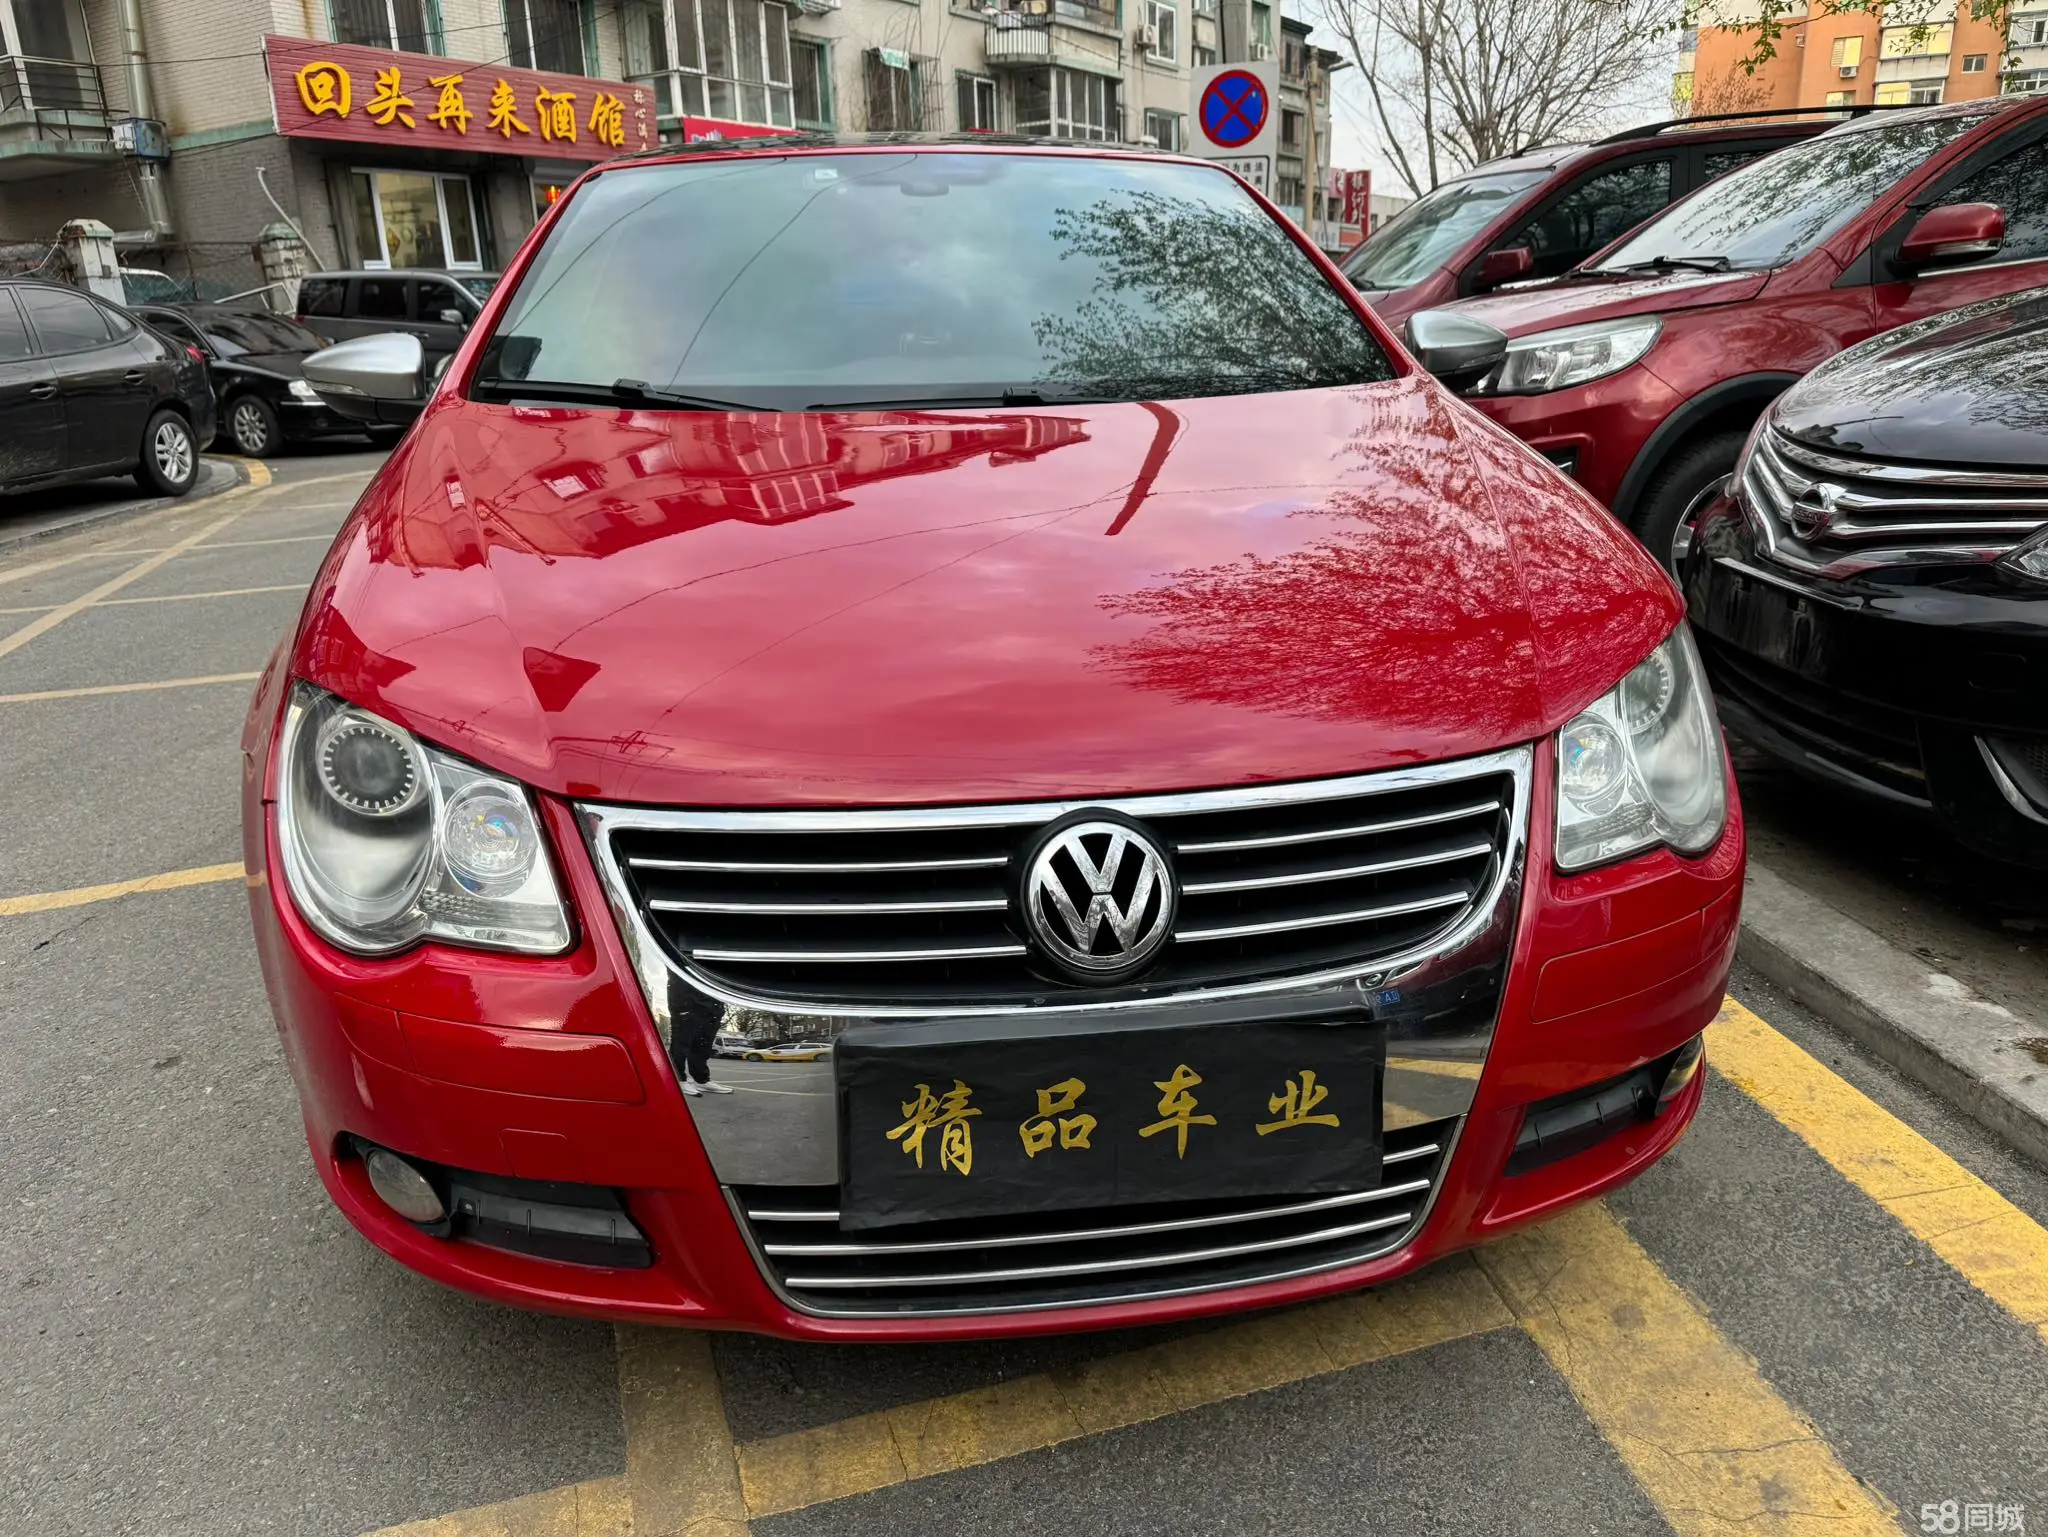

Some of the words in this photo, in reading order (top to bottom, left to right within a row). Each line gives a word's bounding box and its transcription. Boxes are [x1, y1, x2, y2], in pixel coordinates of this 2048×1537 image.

[294, 61, 627, 149] 回头再来酒馆
[886, 1063, 1340, 1176] 精品车业
